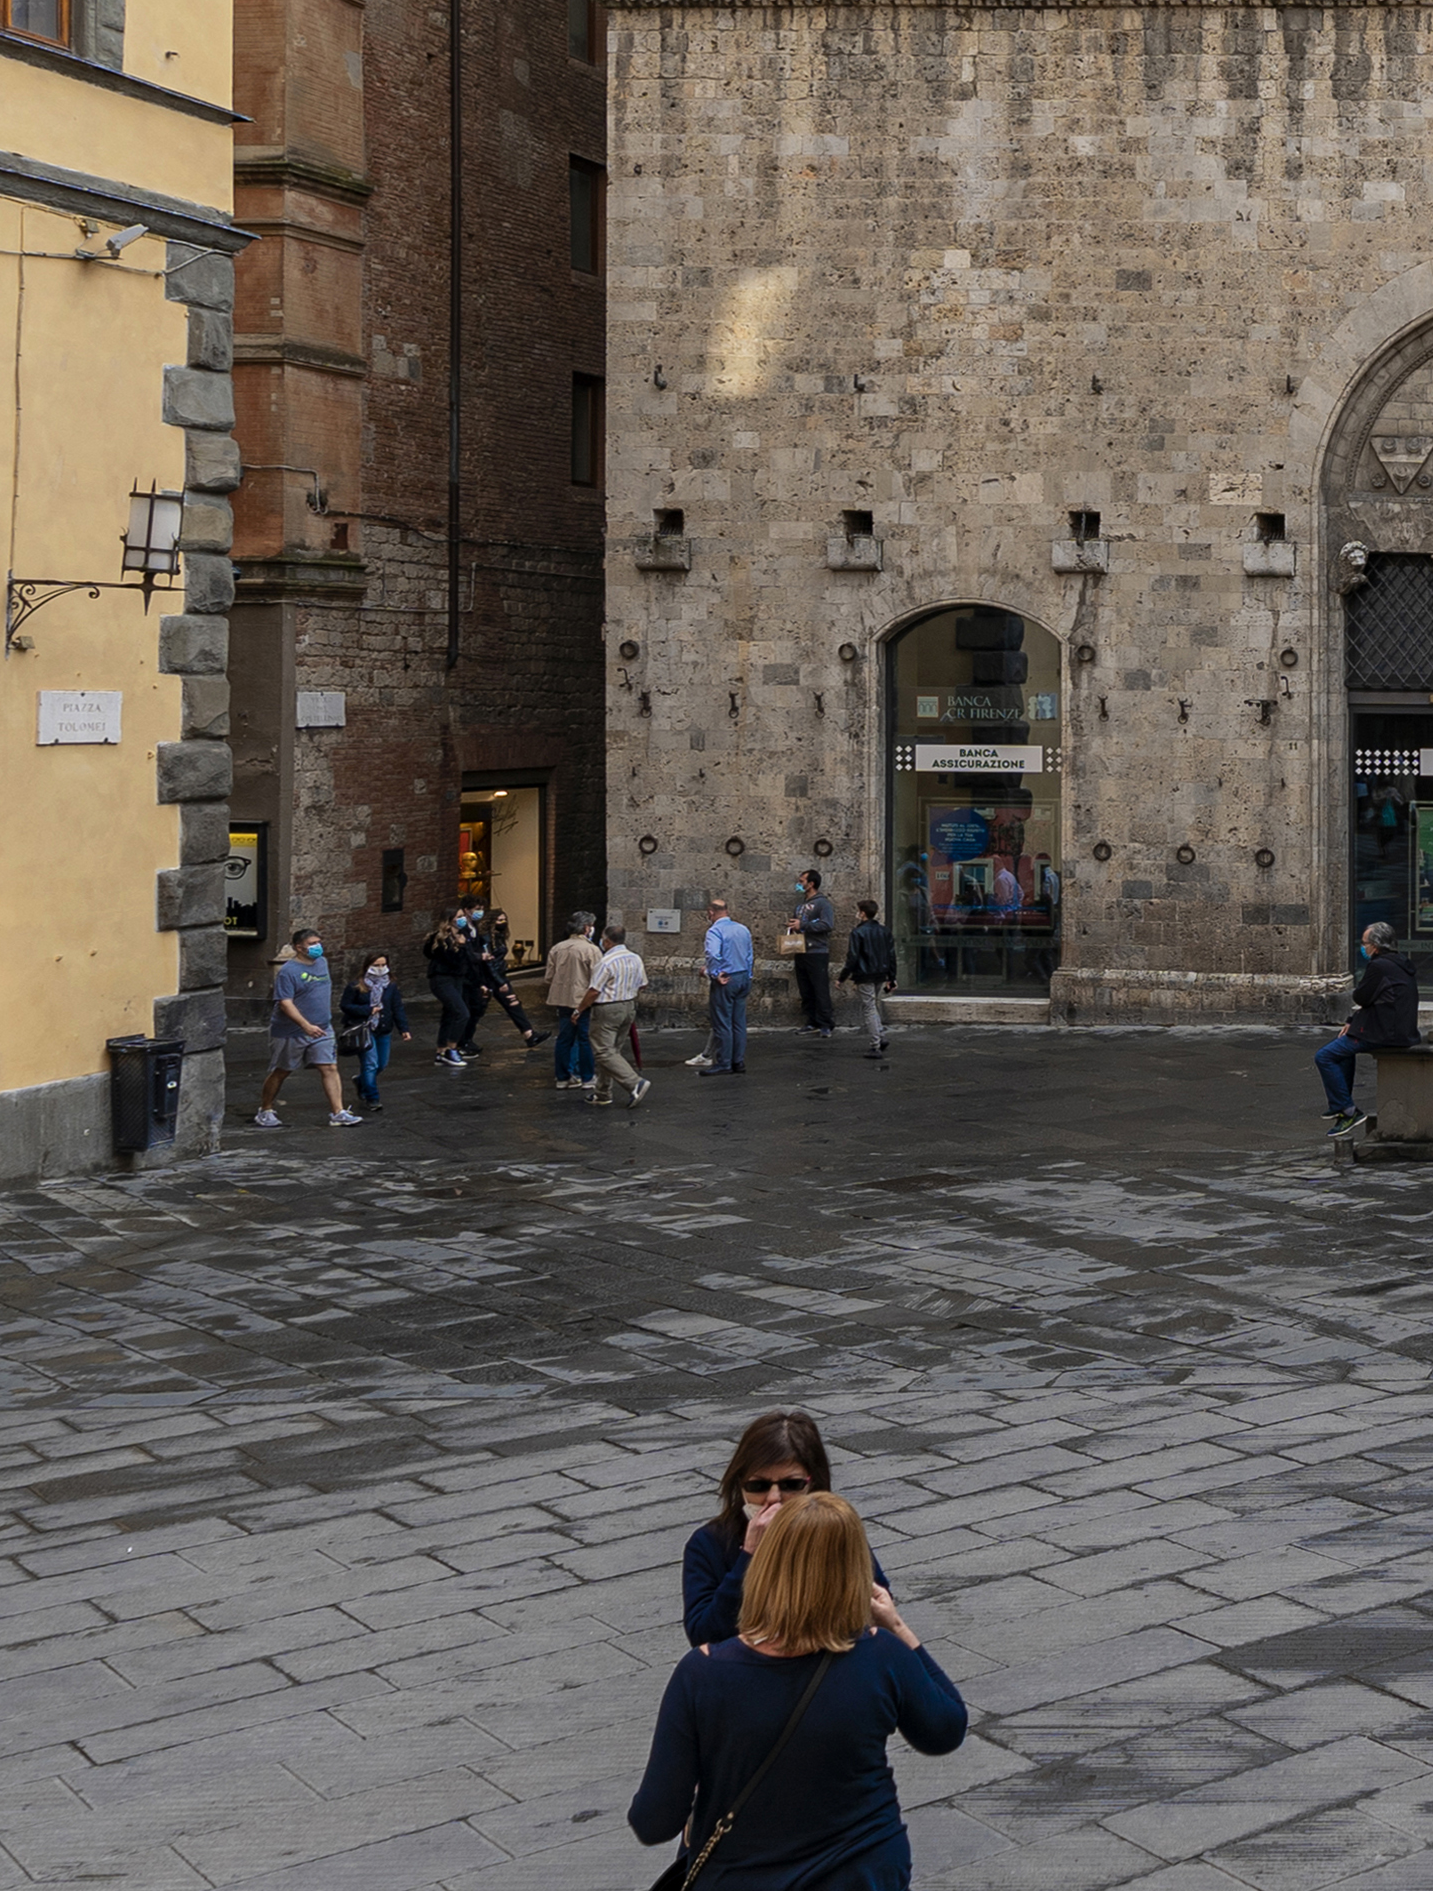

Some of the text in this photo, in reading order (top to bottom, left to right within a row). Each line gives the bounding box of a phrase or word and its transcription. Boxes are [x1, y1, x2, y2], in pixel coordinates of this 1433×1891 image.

[948, 696, 991, 707] BANCA
[63, 703, 101, 712] PIAZZA
[947, 707, 1022, 720] CR FIRENZE
[58, 722, 106, 732] TOLOMEI
[959, 749, 999, 758] BANCA
[932, 759, 1025, 769] ASSICURAZIONE
